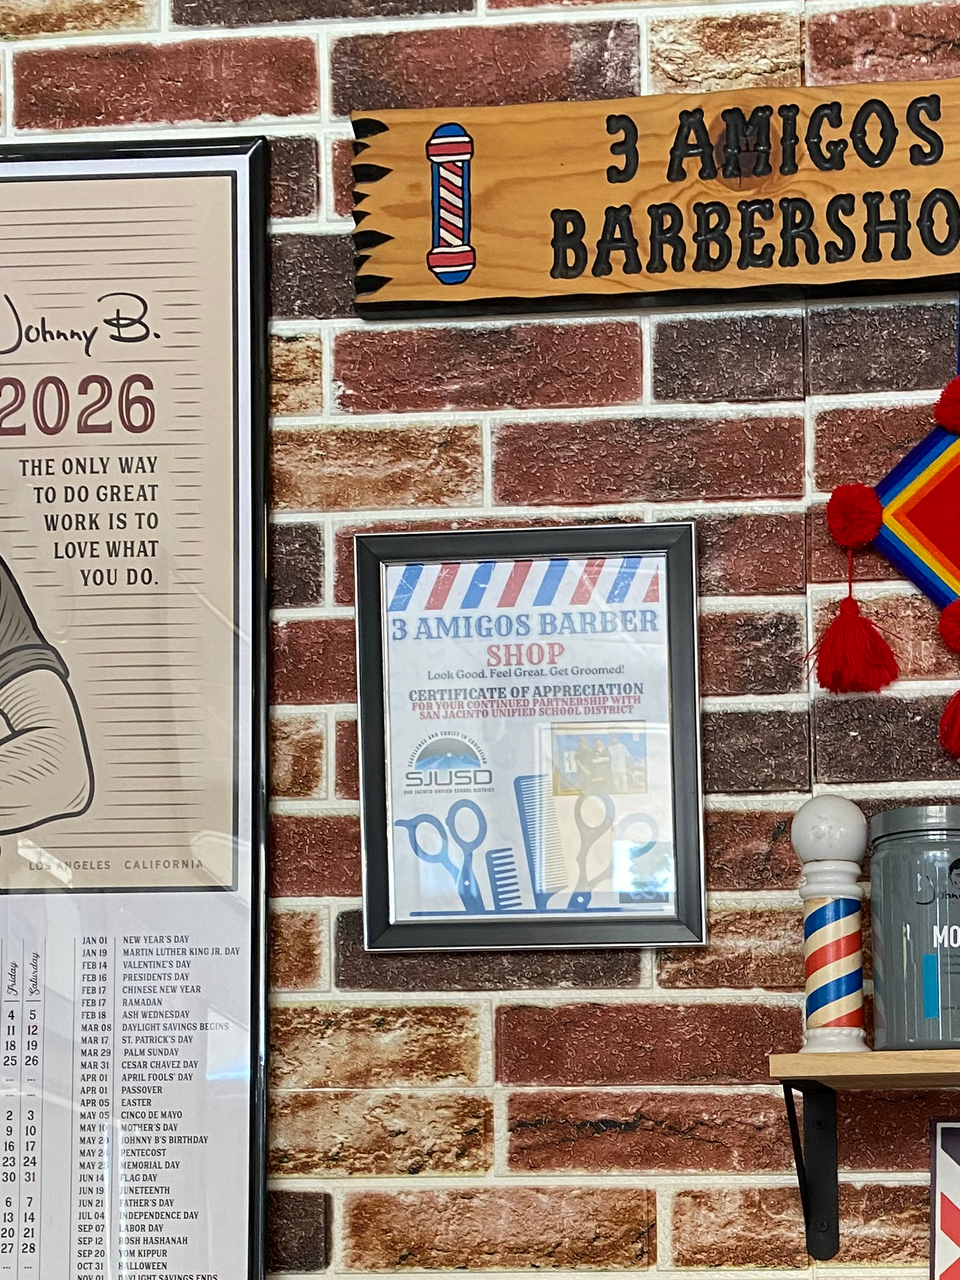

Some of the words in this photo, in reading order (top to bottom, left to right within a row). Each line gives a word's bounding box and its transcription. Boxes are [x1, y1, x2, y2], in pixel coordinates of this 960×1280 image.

[605, 113, 639, 184] 3
[667, 93, 942, 182] AMIGOS
[0, 294, 98, 357] Johnny
[97, 292, 161, 342] B.
[0, 374, 155, 436] 2026
[19, 459, 55, 476] THE
[62, 457, 110, 474] ONLY
[118, 456, 158, 473] WAY
[34, 487, 56, 503] TO
[64, 486, 89, 502] DO
[96, 485, 158, 501] GREAT
[44, 513, 100, 531] WORK
[109, 513, 127, 530] IS
[135, 513, 158, 529] TO
[54, 541, 100, 559] LOVE
[106, 541, 158, 557] WHAT
[80, 569, 117, 586] YOU
[127, 568, 158, 585] DO.
[392, 618, 407, 641] 3
[414, 613, 530, 640] AMIGOS
[539, 609, 659, 636] BARBER
[487, 642, 565, 667] SHOP
[428, 670, 454, 680] Look
[456, 669, 488, 679] Good.
[490, 668, 512, 678] Feel
[514, 667, 547, 677] Great.
[550, 666, 569, 676] Get
[571, 665, 625, 675] Groomed!
[409, 687, 507, 701] CERTIFICATE
[510, 687, 529, 699] OF
[533, 682, 644, 697] APPRECIATION
[405, 770, 492, 787] SJUSD
[29, 861, 51, 870] LOS
[57, 860, 110, 870] ANGELES
[125, 859, 203, 869] CALIFORNIA
[83, 937, 96, 945] JAN
[123, 936, 142, 944] NEW
[174, 935, 189, 943] DAY
[83, 949, 96, 957] JAN
[99, 949, 107, 957] 19
[123, 948, 153, 956] MARTIN
[156, 948, 187, 956] LUTHER
[225, 947, 240, 955] DAY
